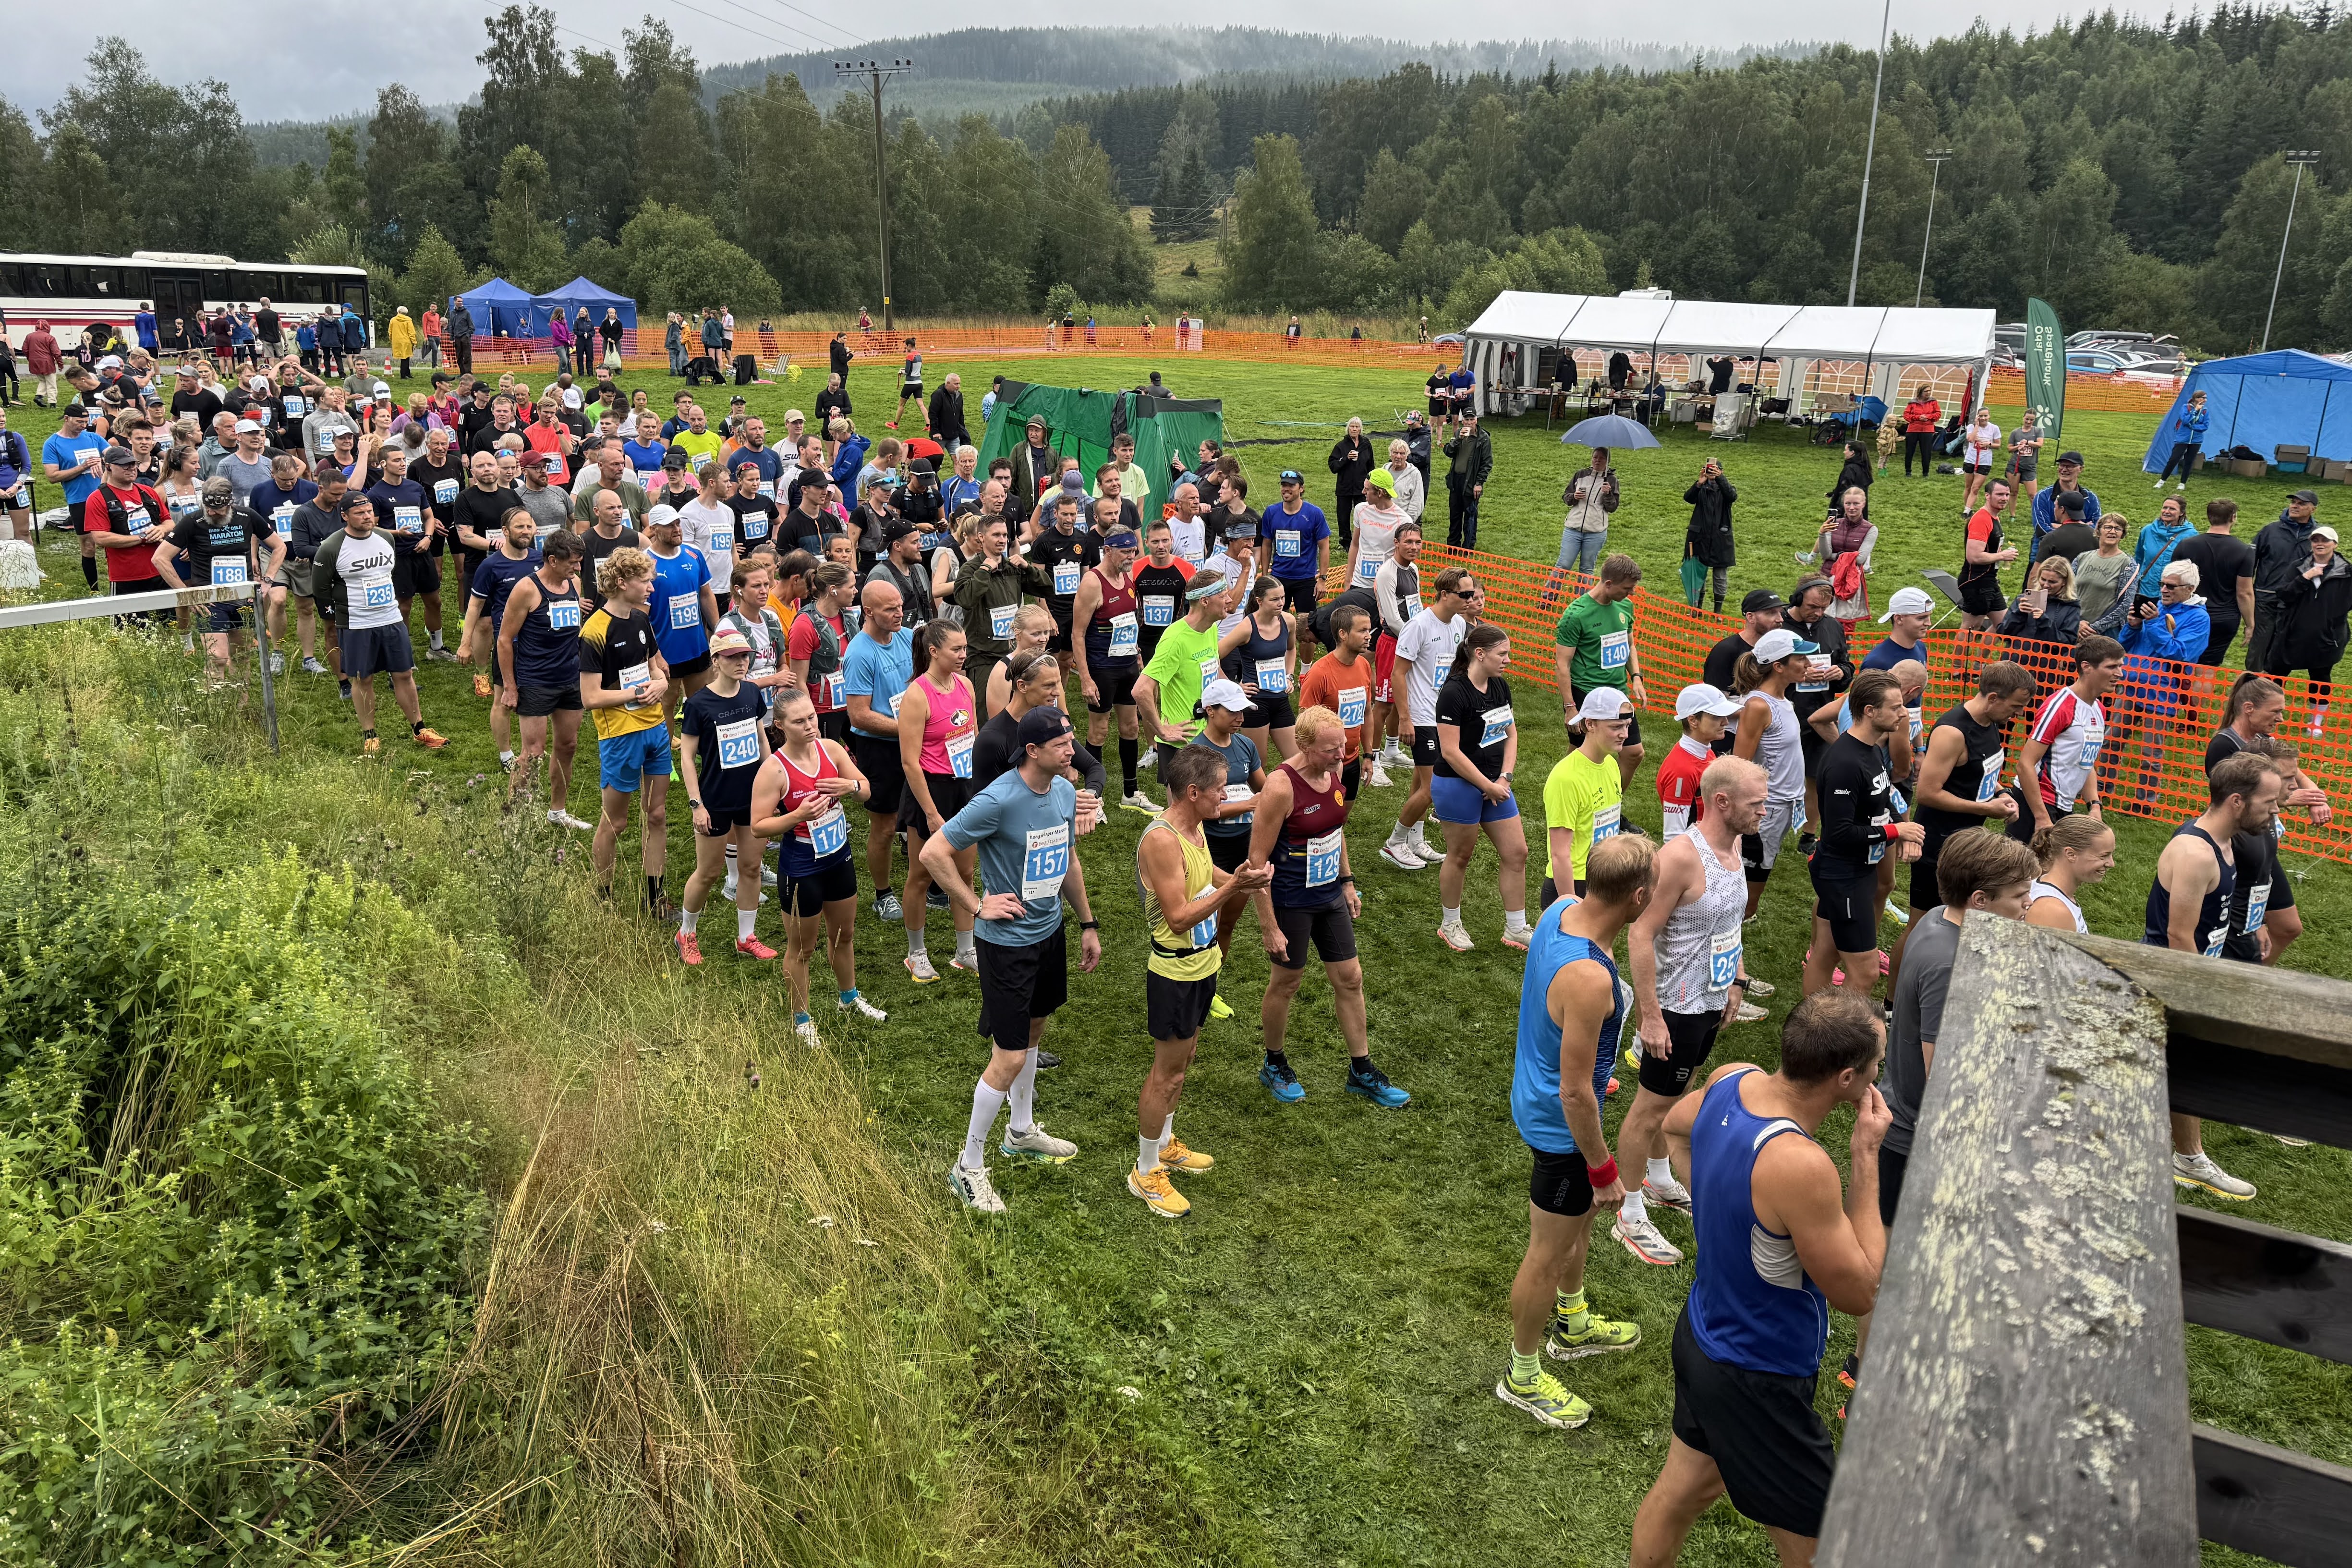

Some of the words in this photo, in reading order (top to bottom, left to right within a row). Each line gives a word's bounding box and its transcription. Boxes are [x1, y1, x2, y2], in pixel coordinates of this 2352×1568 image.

[80, 353, 91, 363] 10
[286, 402, 302, 412] 118
[261, 414, 271, 425] 37
[322, 433, 333, 443] 22
[550, 460, 561, 470] 62
[19, 491, 29, 503] 26
[439, 488, 457, 501] 216
[400, 517, 420, 528] 249
[748, 522, 766, 535] 167
[210, 530, 244, 540] MARATON
[714, 535, 730, 548] 195
[1278, 542, 1297, 553] 124
[349, 552, 393, 573] swix
[1194, 560, 1203, 571] 80
[1363, 562, 1381, 574] 178
[217, 568, 243, 582] 188
[1058, 577, 1078, 590] 158
[370, 585, 391, 605] 235
[557, 609, 579, 624] 115
[676, 606, 698, 624] 199
[1147, 608, 1170, 621] 137
[997, 620, 1011, 636] 22
[1115, 627, 1135, 643] 154
[1605, 645, 1626, 663] 140
[882, 660, 907, 673] CRAFT
[1263, 674, 1283, 688] 146
[718, 708, 745, 719] CRAFT
[1343, 704, 1364, 723] 278
[725, 737, 755, 762] 240
[2085, 744, 2099, 763] 203
[957, 753, 972, 778] 12
[1870, 766, 1891, 795] swi
[1663, 804, 1684, 815] swix
[818, 818, 845, 852] 170
[1033, 847, 1065, 876] 157
[1314, 851, 1339, 878] 129
[961, 1177, 976, 1203] HOKA
